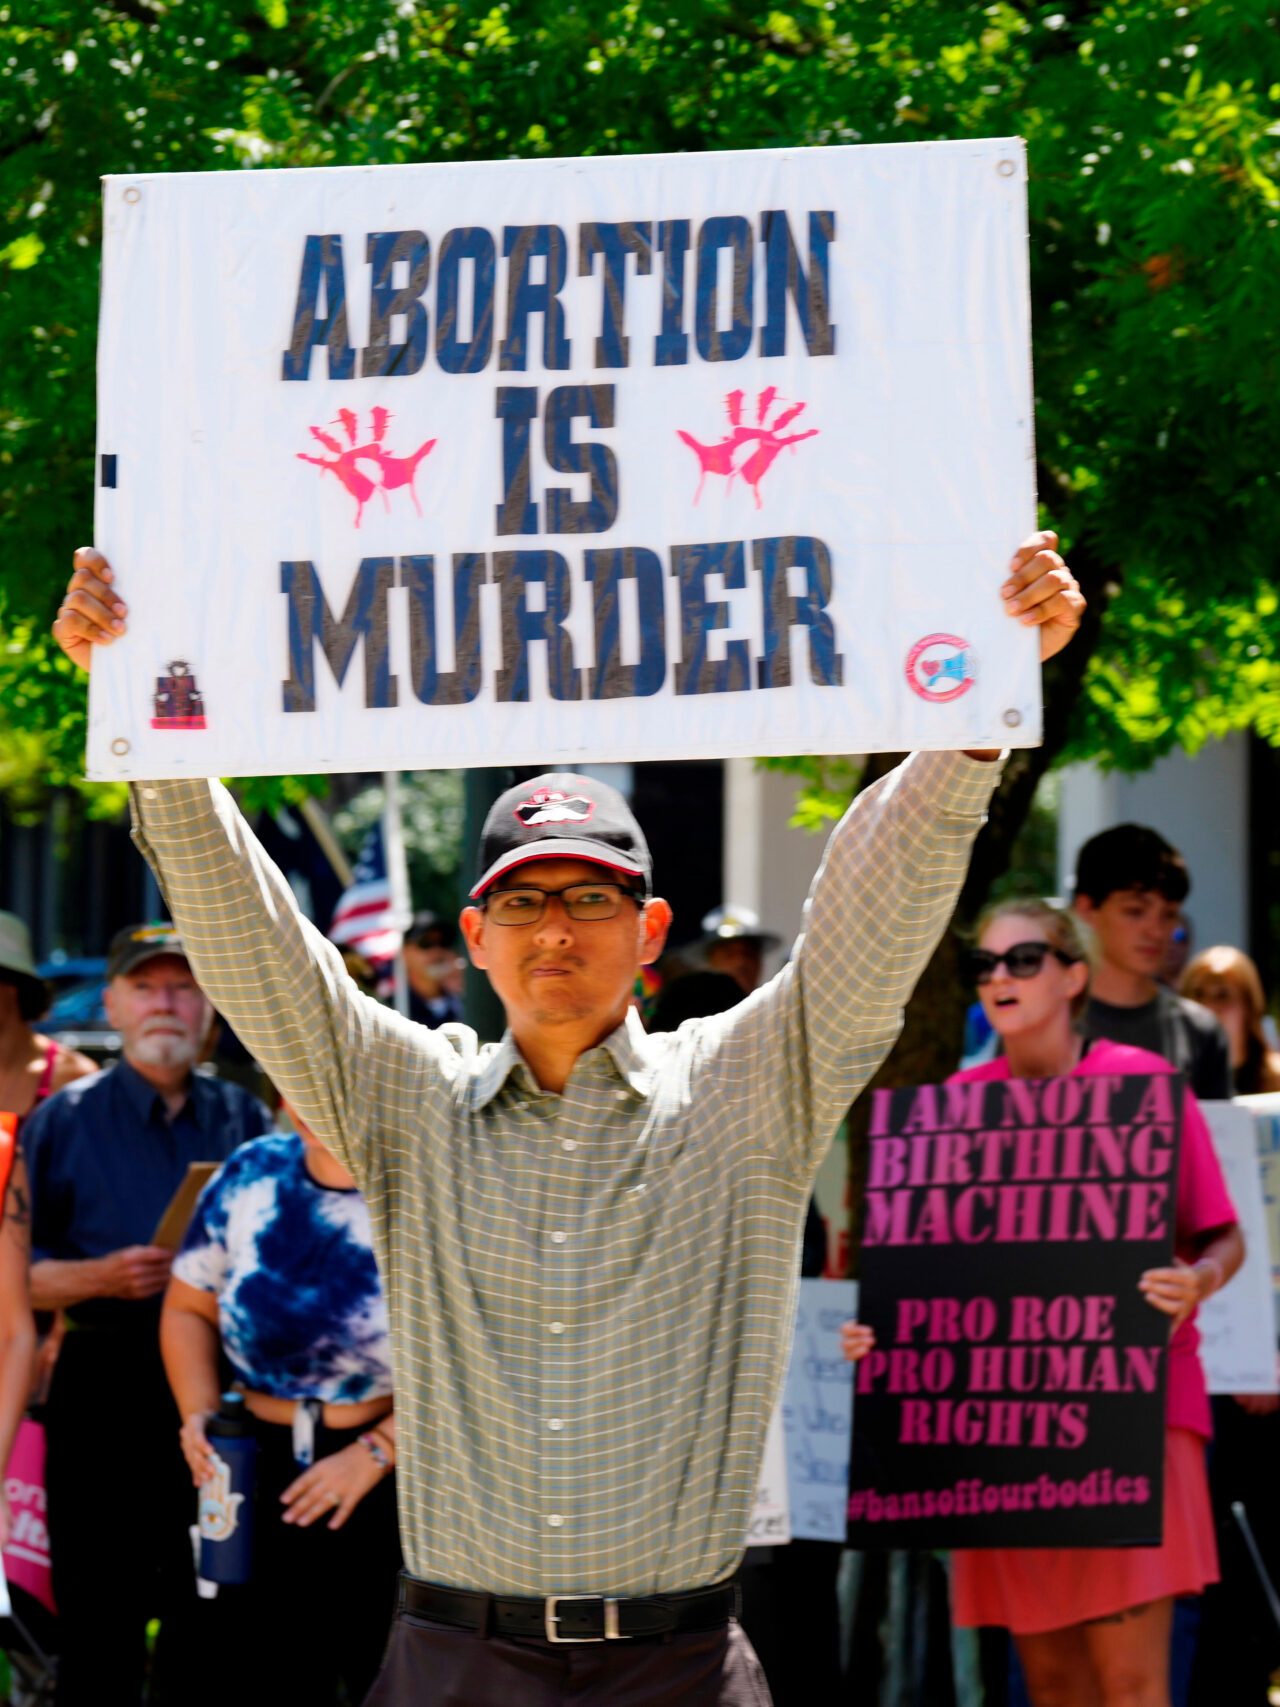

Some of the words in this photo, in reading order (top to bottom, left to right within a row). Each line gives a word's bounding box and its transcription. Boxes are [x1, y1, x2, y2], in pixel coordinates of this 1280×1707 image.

[280, 209, 838, 381] ABORTION
[495, 383, 620, 536] IS
[279, 535, 844, 713] MURDER
[869, 1088, 893, 1137] I
[901, 1082, 988, 1134] AM
[1000, 1076, 1122, 1127] NOT
[1132, 1074, 1175, 1123] A
[867, 1125, 1174, 1189] BIRTHING
[862, 1183, 1169, 1247] MACHINE
[895, 1296, 997, 1343] PRO
[1008, 1295, 1116, 1341] ROE
[855, 1348, 955, 1394] PRO
[967, 1346, 1161, 1393] HUMAN
[899, 1399, 1088, 1449] RIGHTS
[847, 1467, 1150, 1522] #bansoffourbodies
